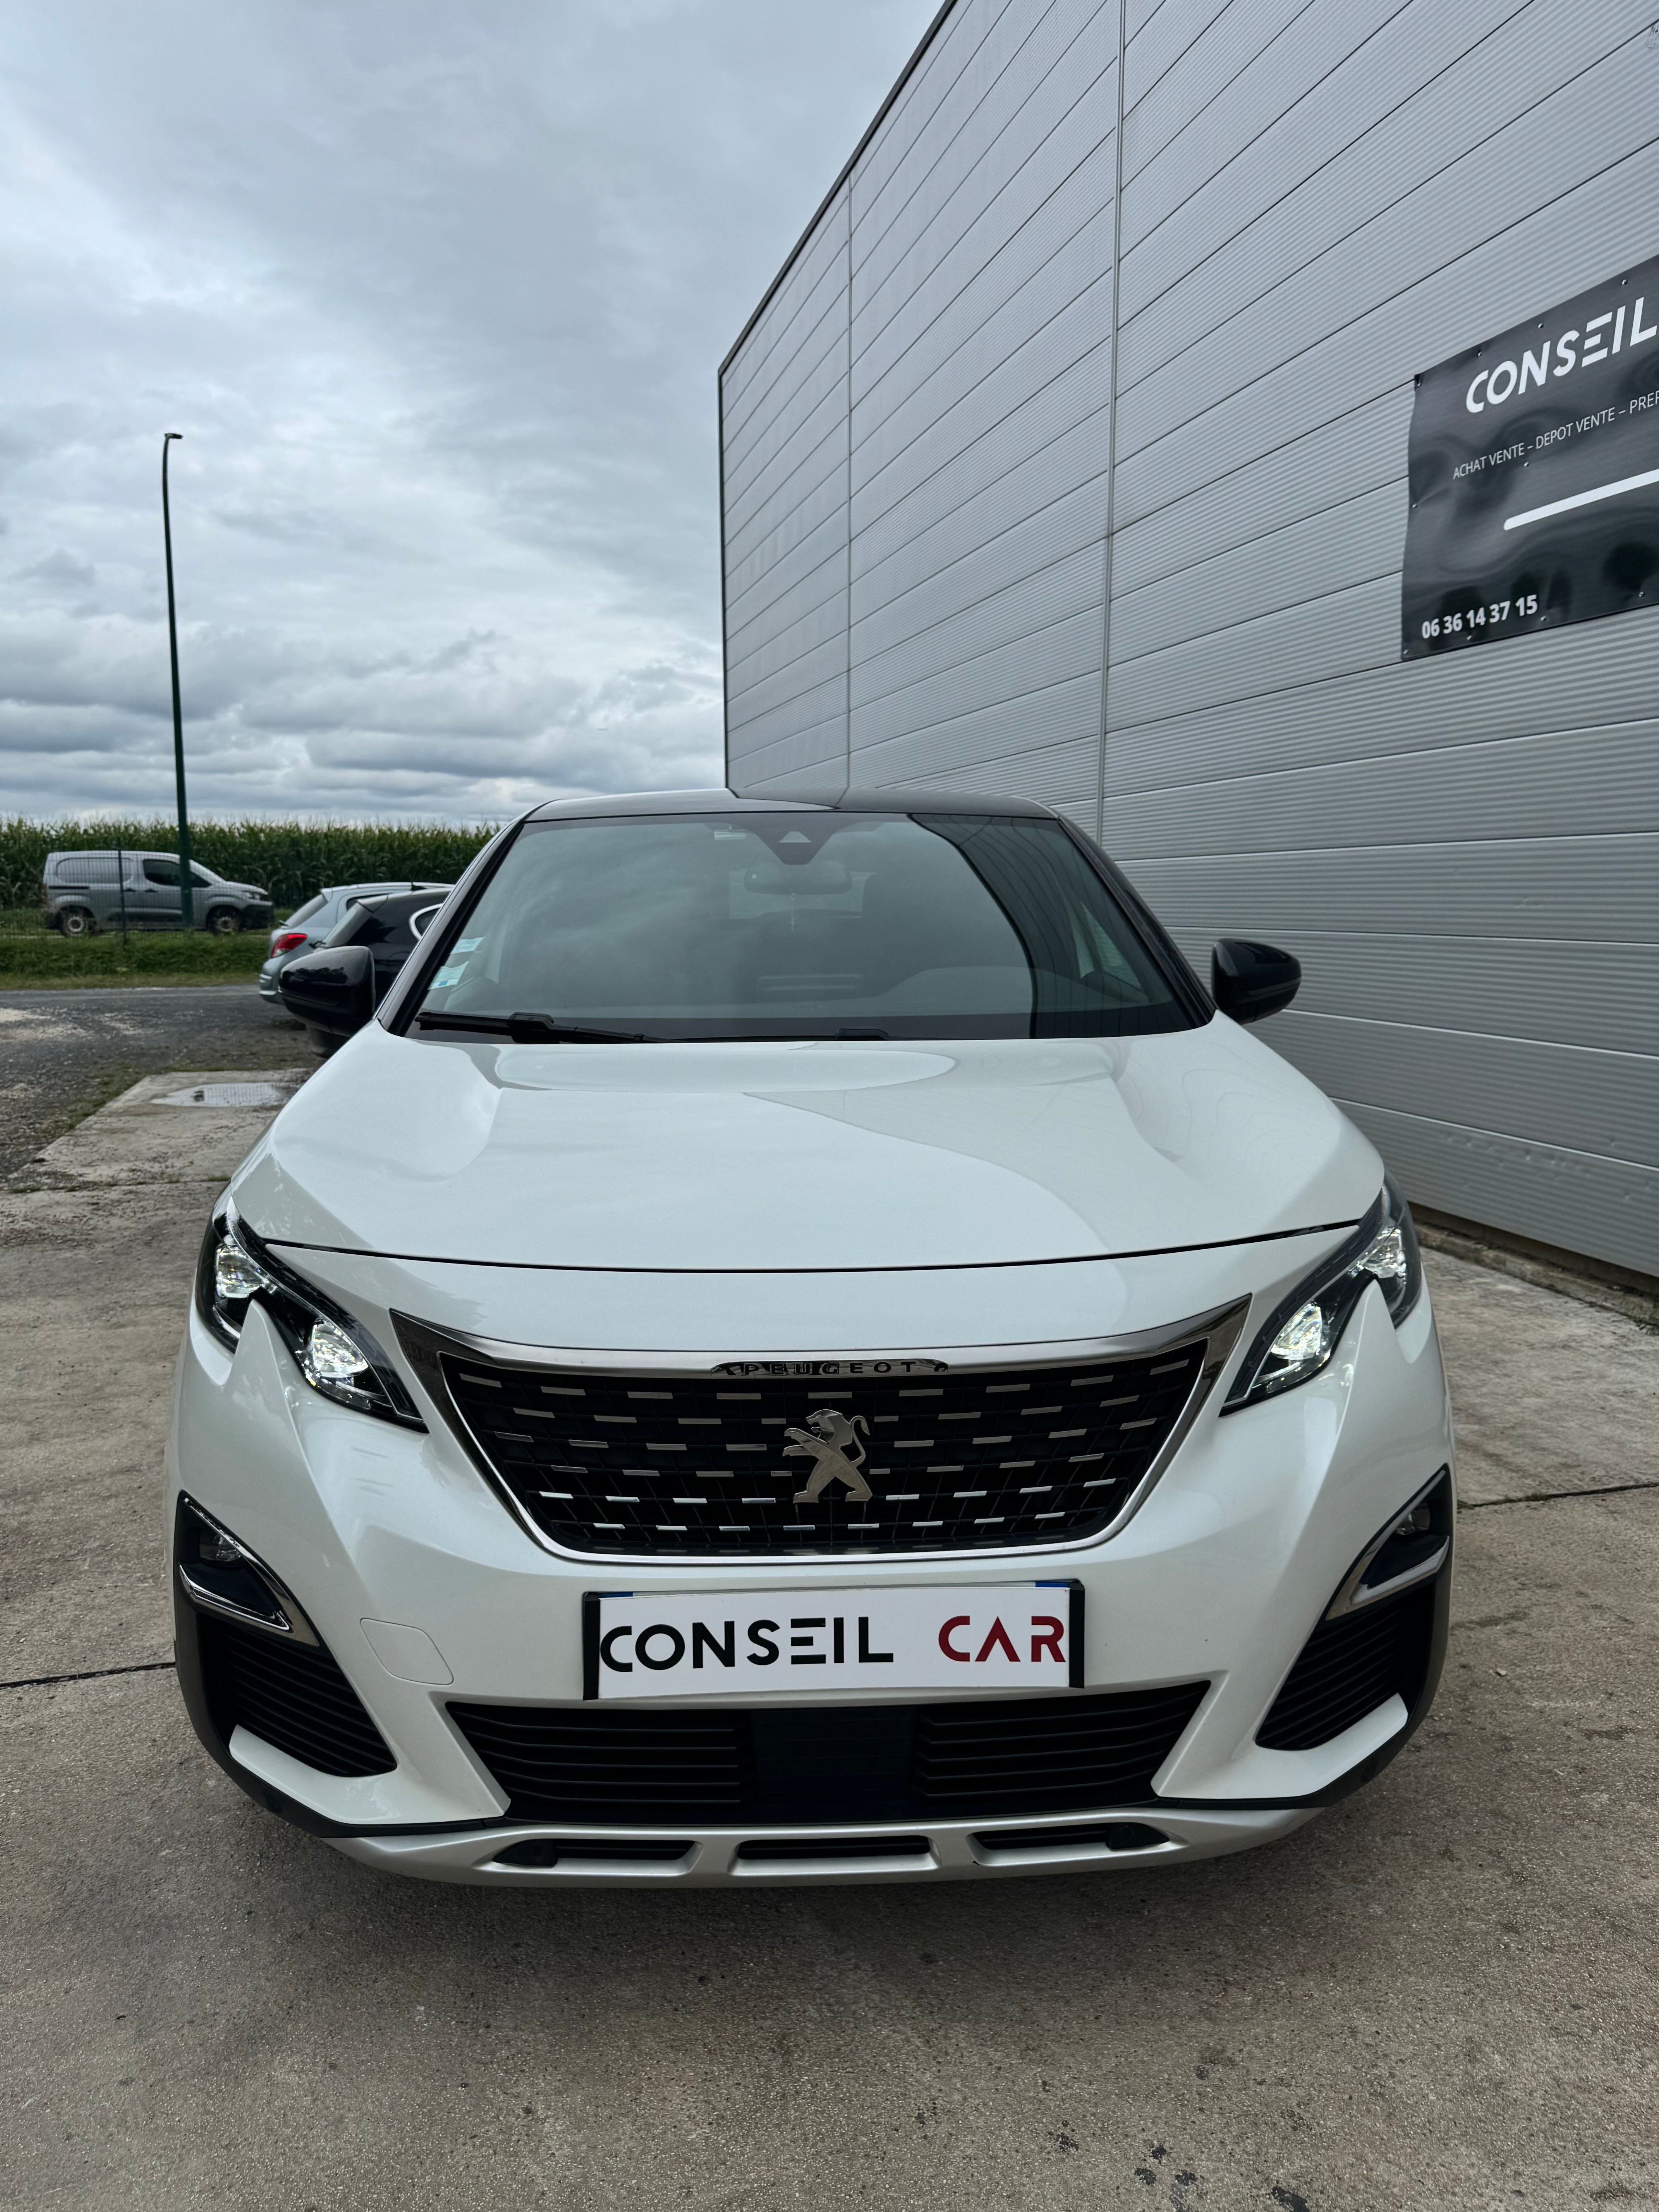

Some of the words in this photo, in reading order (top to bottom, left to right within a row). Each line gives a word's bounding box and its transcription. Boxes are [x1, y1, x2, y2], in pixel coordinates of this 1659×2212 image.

[1466, 296, 1658, 413] CONSEIL
[1453, 456, 1487, 480] ACHAT
[1489, 443, 1525, 465] VENTE
[1536, 423, 1574, 449] DEPOT
[1576, 407, 1616, 433] VENTE
[1422, 618, 1440, 639] 06
[1443, 613, 1463, 634] 36
[1466, 607, 1486, 628] 14
[1489, 601, 1511, 623] 37
[1515, 594, 1538, 616] 15
[744, 1361, 916, 1376] PEUGEOT
[600, 1616, 894, 1673] CONSEIL
[938, 1615, 1066, 1662] CAR
